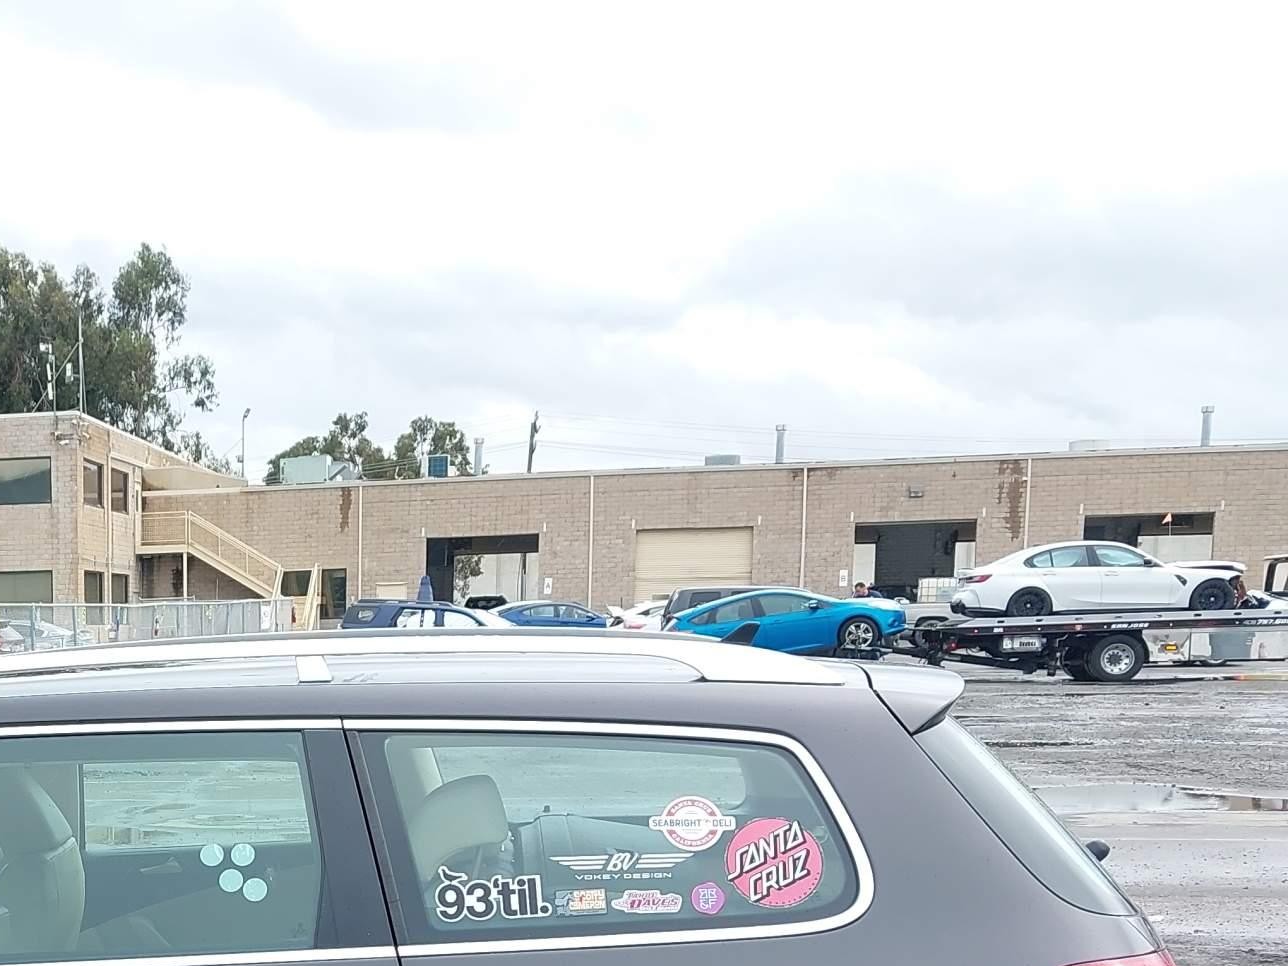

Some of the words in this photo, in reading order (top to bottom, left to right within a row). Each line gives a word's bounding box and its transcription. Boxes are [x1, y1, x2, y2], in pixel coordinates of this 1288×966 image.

[651, 819, 701, 827] SEABRIGHT
[712, 818, 732, 827] DELI
[727, 820, 807, 882] SANTA
[623, 872, 672, 880] DESIGN
[748, 848, 811, 903] CRUZ
